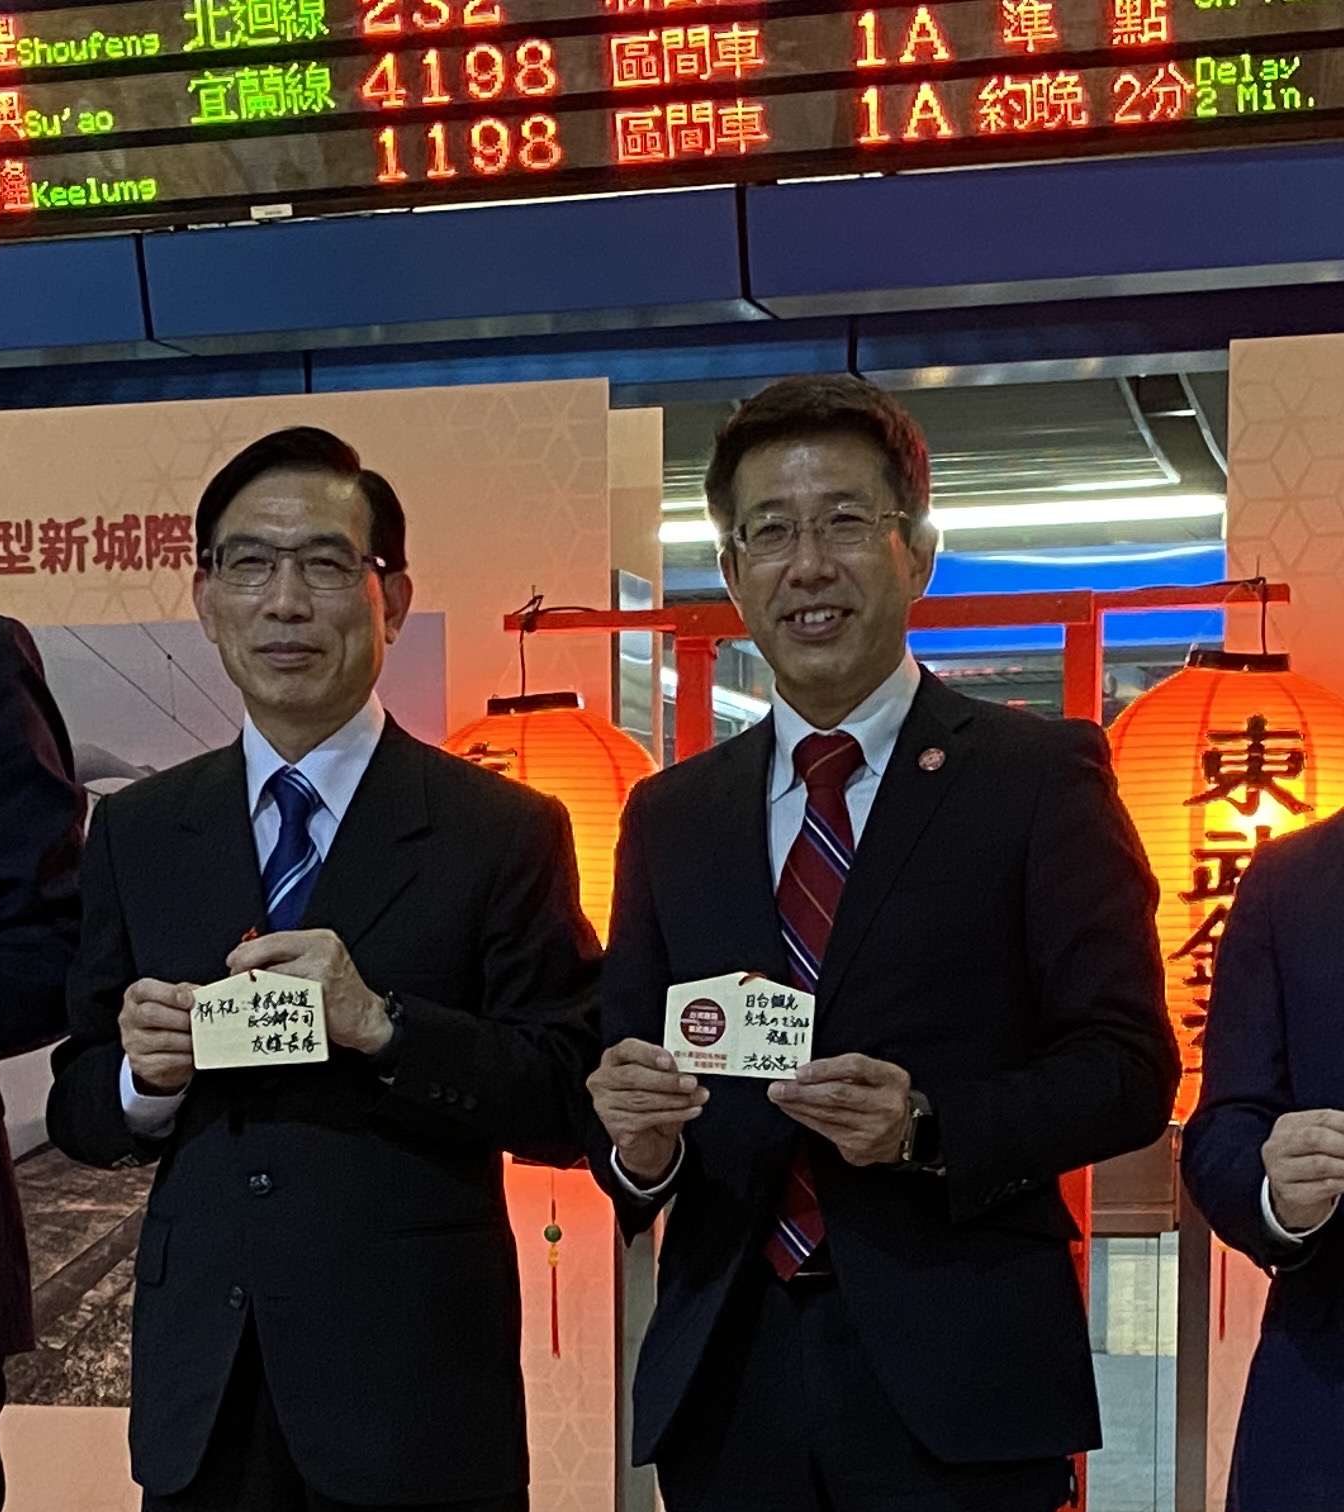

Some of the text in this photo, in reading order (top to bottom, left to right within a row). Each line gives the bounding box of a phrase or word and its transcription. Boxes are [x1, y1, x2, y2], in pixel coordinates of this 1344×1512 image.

[18, 32, 160, 67] Shoufeng
[25, 104, 113, 139] Su'ao
[187, 61, 336, 127] 宜蘭線
[362, 39, 556, 108] 4198
[610, 23, 764, 90] 區間車
[856, 7, 950, 67] 1A
[1196, 54, 1300, 86] Delay
[1196, 82, 1315, 118] 2 Min.
[33, 176, 157, 210] Keelung
[376, 114, 561, 184] 1198
[616, 98, 769, 165] 區間車
[859, 83, 953, 145] 1A
